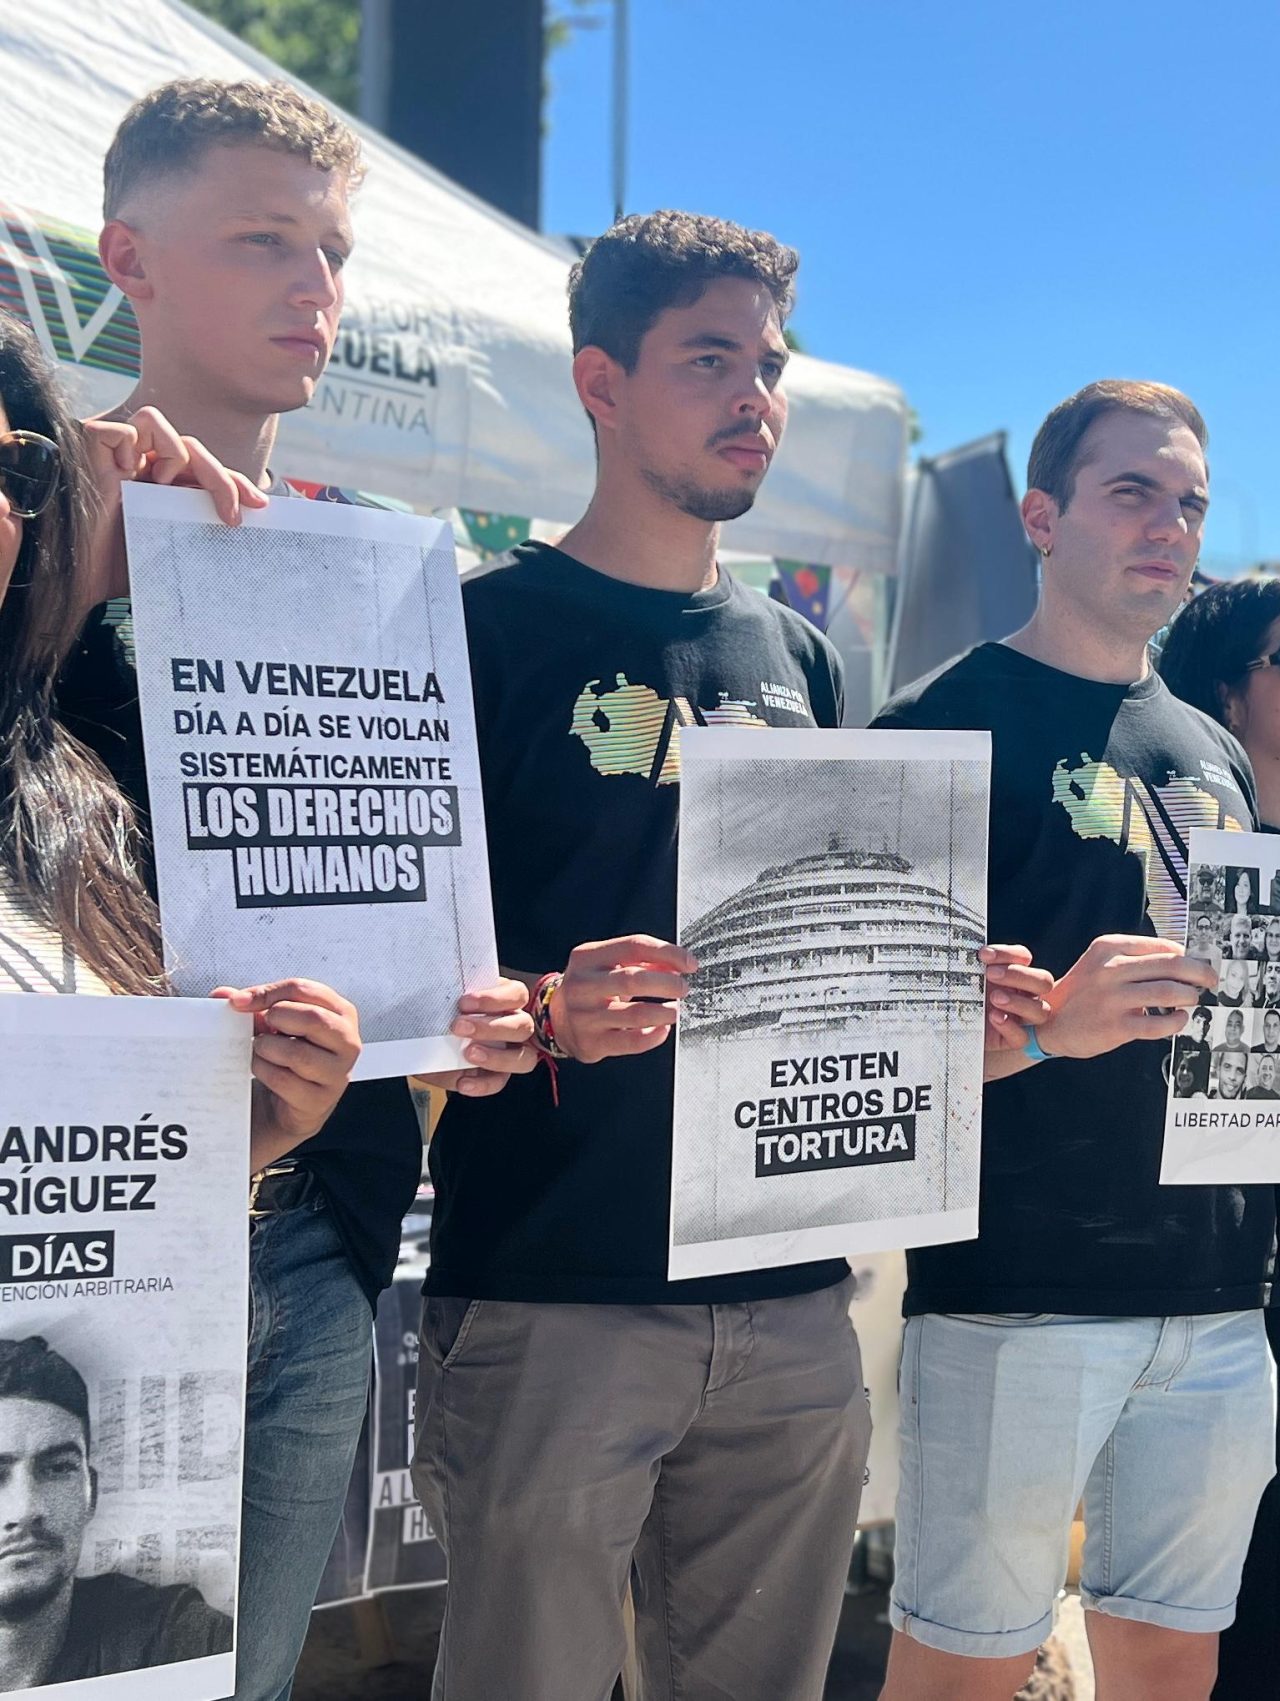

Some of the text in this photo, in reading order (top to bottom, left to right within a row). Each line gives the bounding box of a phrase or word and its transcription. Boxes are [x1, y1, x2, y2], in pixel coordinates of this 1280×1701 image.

[329, 330, 437, 388] UELA
[306, 385, 430, 435] NTINA
[171, 657, 445, 703] EN VENEZUELA
[174, 702, 450, 742] DÍA A DÍA SE VIOLAN
[180, 746, 451, 780] SISTEMÁTICAMENTE
[186, 786, 453, 838] LOS DERECHOS
[236, 843, 422, 897] HUMANOS
[770, 1051, 899, 1088] EXISTEN
[734, 1084, 932, 1129] CENTROS DE
[1174, 1112, 1250, 1127] LIBERTAD
[0, 1113, 188, 1163] ANDRÉS
[757, 1122, 908, 1166] TORTURA
[0, 1165, 156, 1215] RÍGUEZ
[12, 1235, 108, 1277] DÍAS
[73, 1277, 174, 1298] ARBITRARIA
